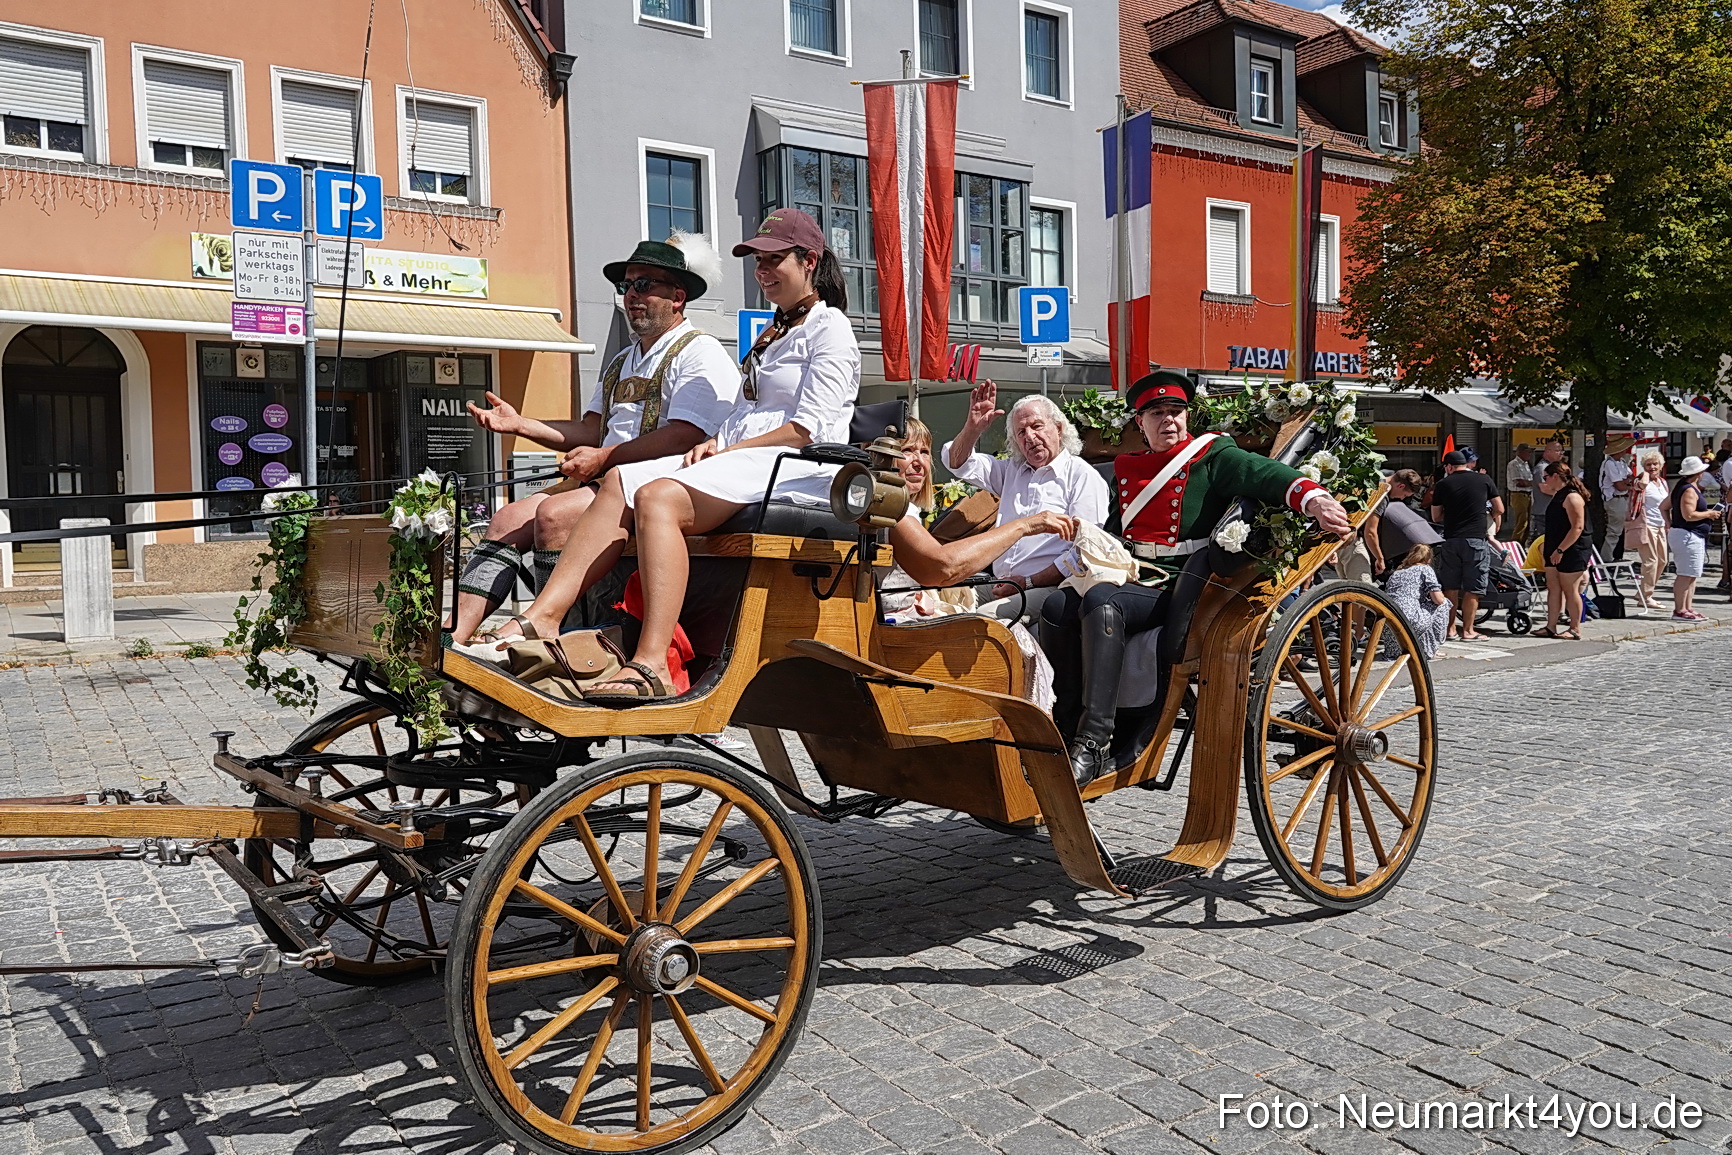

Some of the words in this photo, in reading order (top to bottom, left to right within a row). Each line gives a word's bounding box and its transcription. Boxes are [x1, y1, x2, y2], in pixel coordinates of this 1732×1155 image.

[248, 170, 286, 220] P
[331, 179, 367, 228] P
[248, 239, 266, 247] nur
[271, 240, 289, 249] mit
[239, 247, 299, 261] Parkschein
[244, 261, 295, 273] werktags
[398, 258, 449, 270] STUDIO
[383, 274, 394, 286] &
[401, 272, 452, 290] Mehr
[239, 284, 252, 293] Sa
[233, 304, 284, 312] HANDYPARKEN
[1031, 294, 1058, 336] P
[1227, 345, 1362, 373] TABAKAREN
